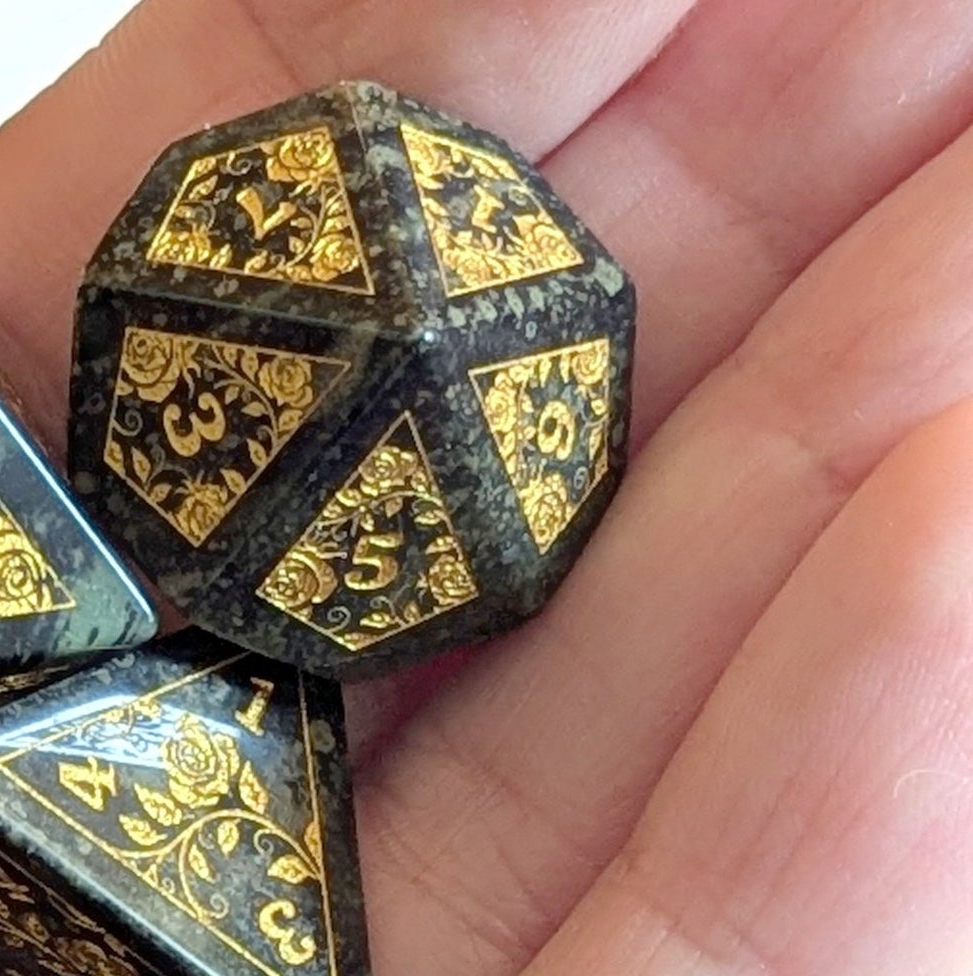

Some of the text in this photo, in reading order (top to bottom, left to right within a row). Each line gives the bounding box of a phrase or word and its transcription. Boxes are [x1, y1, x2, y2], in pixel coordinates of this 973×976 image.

[162, 391, 226, 458] 3
[344, 532, 404, 590] 5
[235, 677, 274, 736] 1
[58, 755, 118, 811] 4
[259, 900, 317, 966] 3
